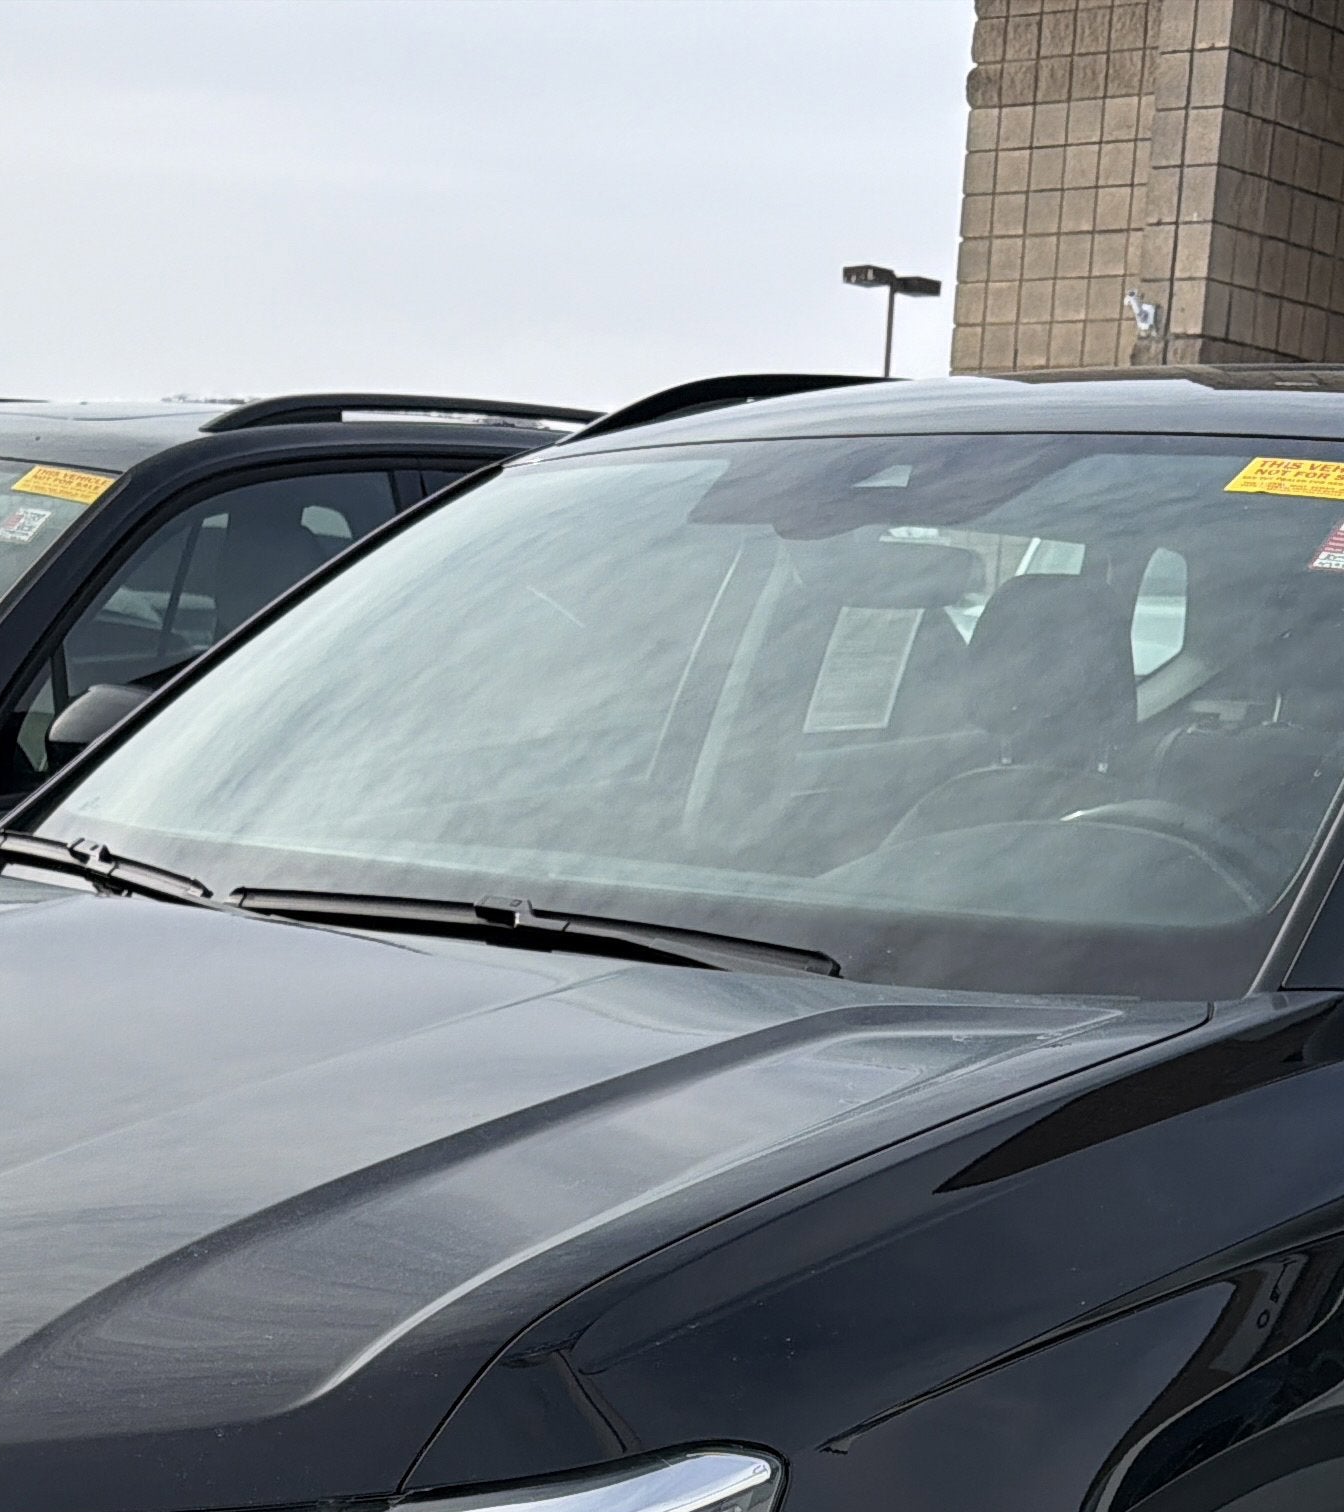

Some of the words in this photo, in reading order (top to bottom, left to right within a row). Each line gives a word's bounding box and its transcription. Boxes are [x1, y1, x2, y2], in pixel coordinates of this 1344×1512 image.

[1259, 460, 1303, 471] THIS
[1254, 469, 1290, 477] NOT
[1294, 471, 1328, 480] FOR
